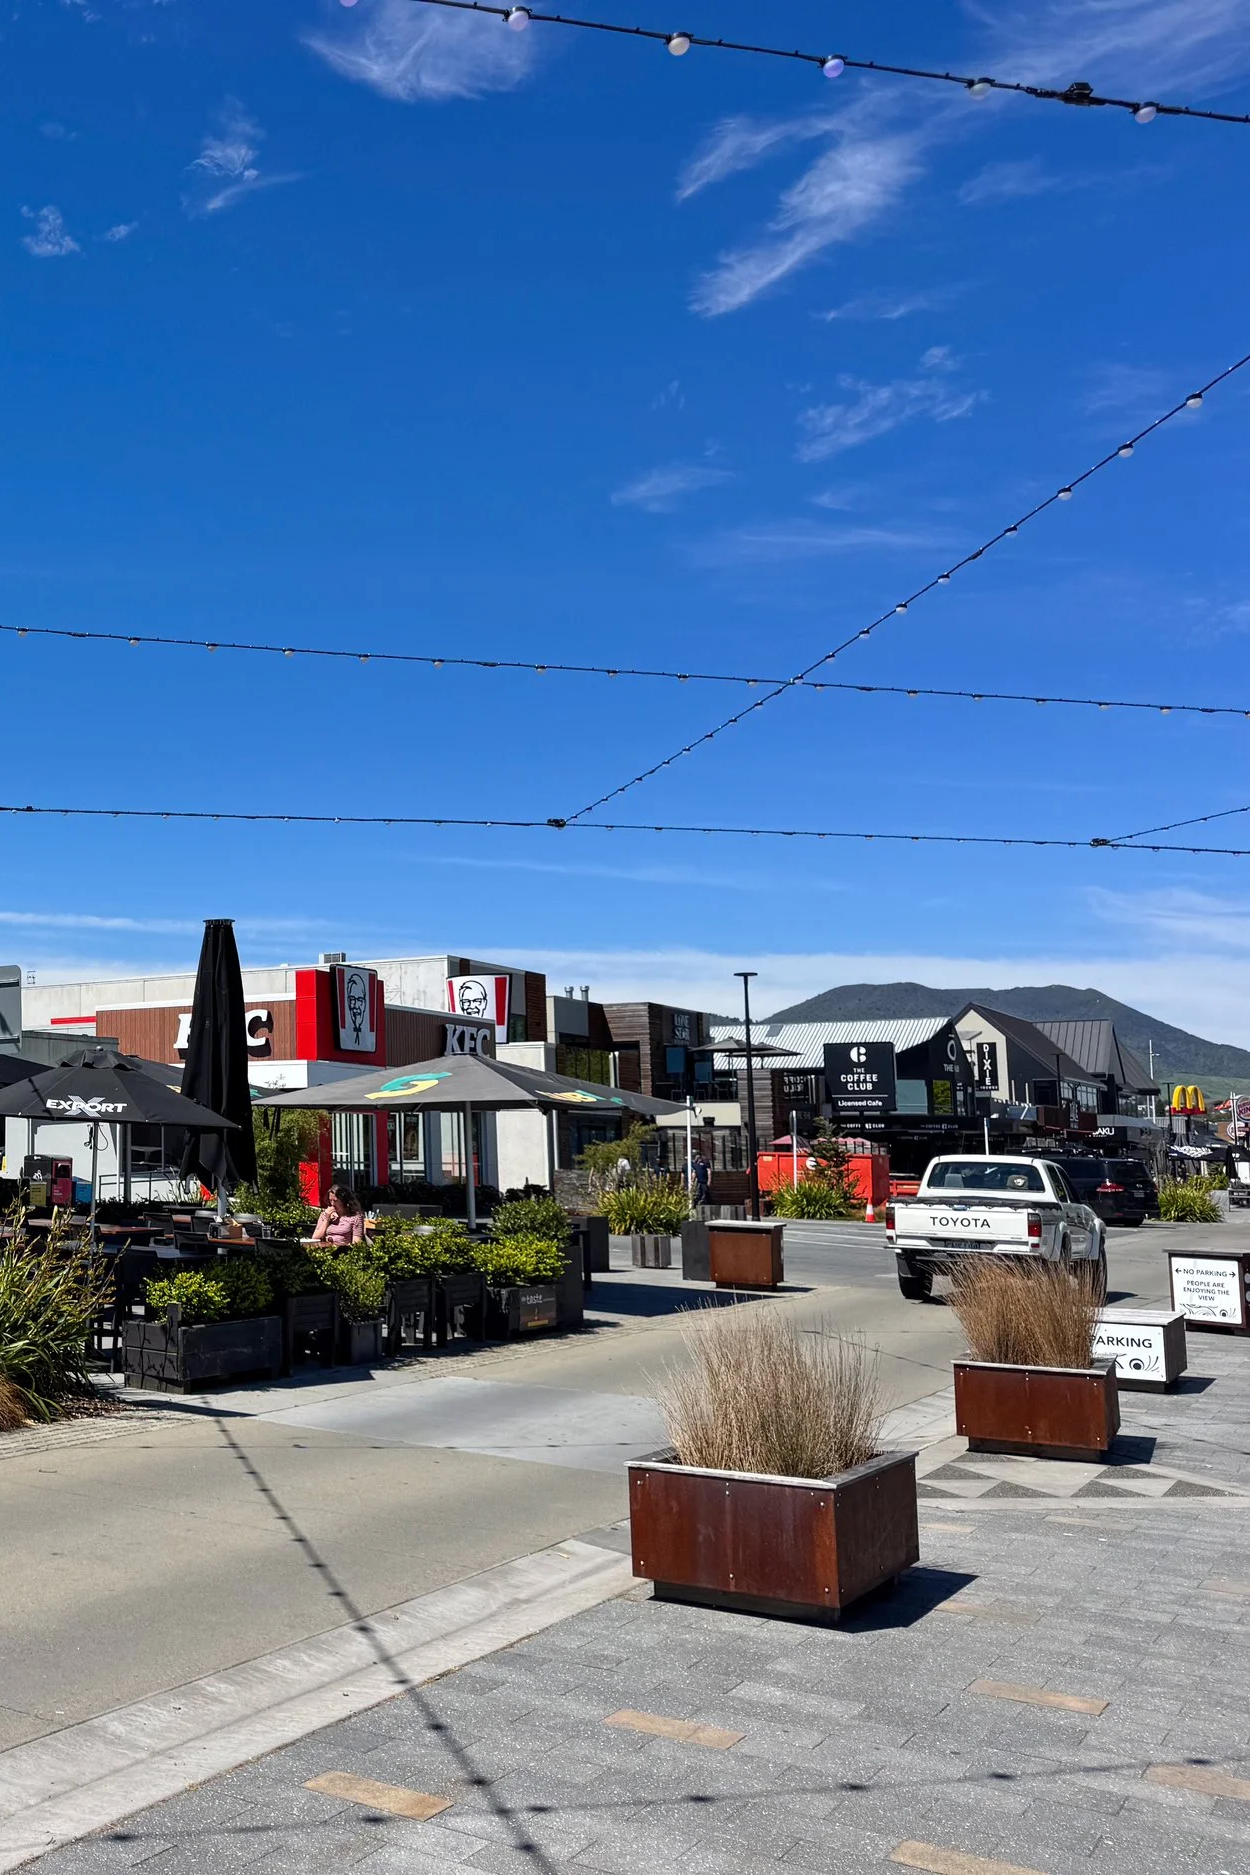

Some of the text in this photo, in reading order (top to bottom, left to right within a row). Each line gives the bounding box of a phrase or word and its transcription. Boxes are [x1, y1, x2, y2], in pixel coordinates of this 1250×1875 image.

[445, 1023, 491, 1057] KFC
[982, 1043, 991, 1085] DIXIE
[840, 1073, 878, 1082] COFFEE
[847, 1082, 873, 1091] CLUB
[46, 1097, 128, 1116] EXPORT
[837, 1099, 883, 1107] Licensed Cafe
[1238, 1106, 1250, 1116] KIN
[930, 1216, 991, 1229] TOYOTA
[1196, 1269, 1228, 1278] PARKING
[1187, 1280, 1212, 1288] PEOPLE
[1183, 1286, 1216, 1295] ENJOYING
